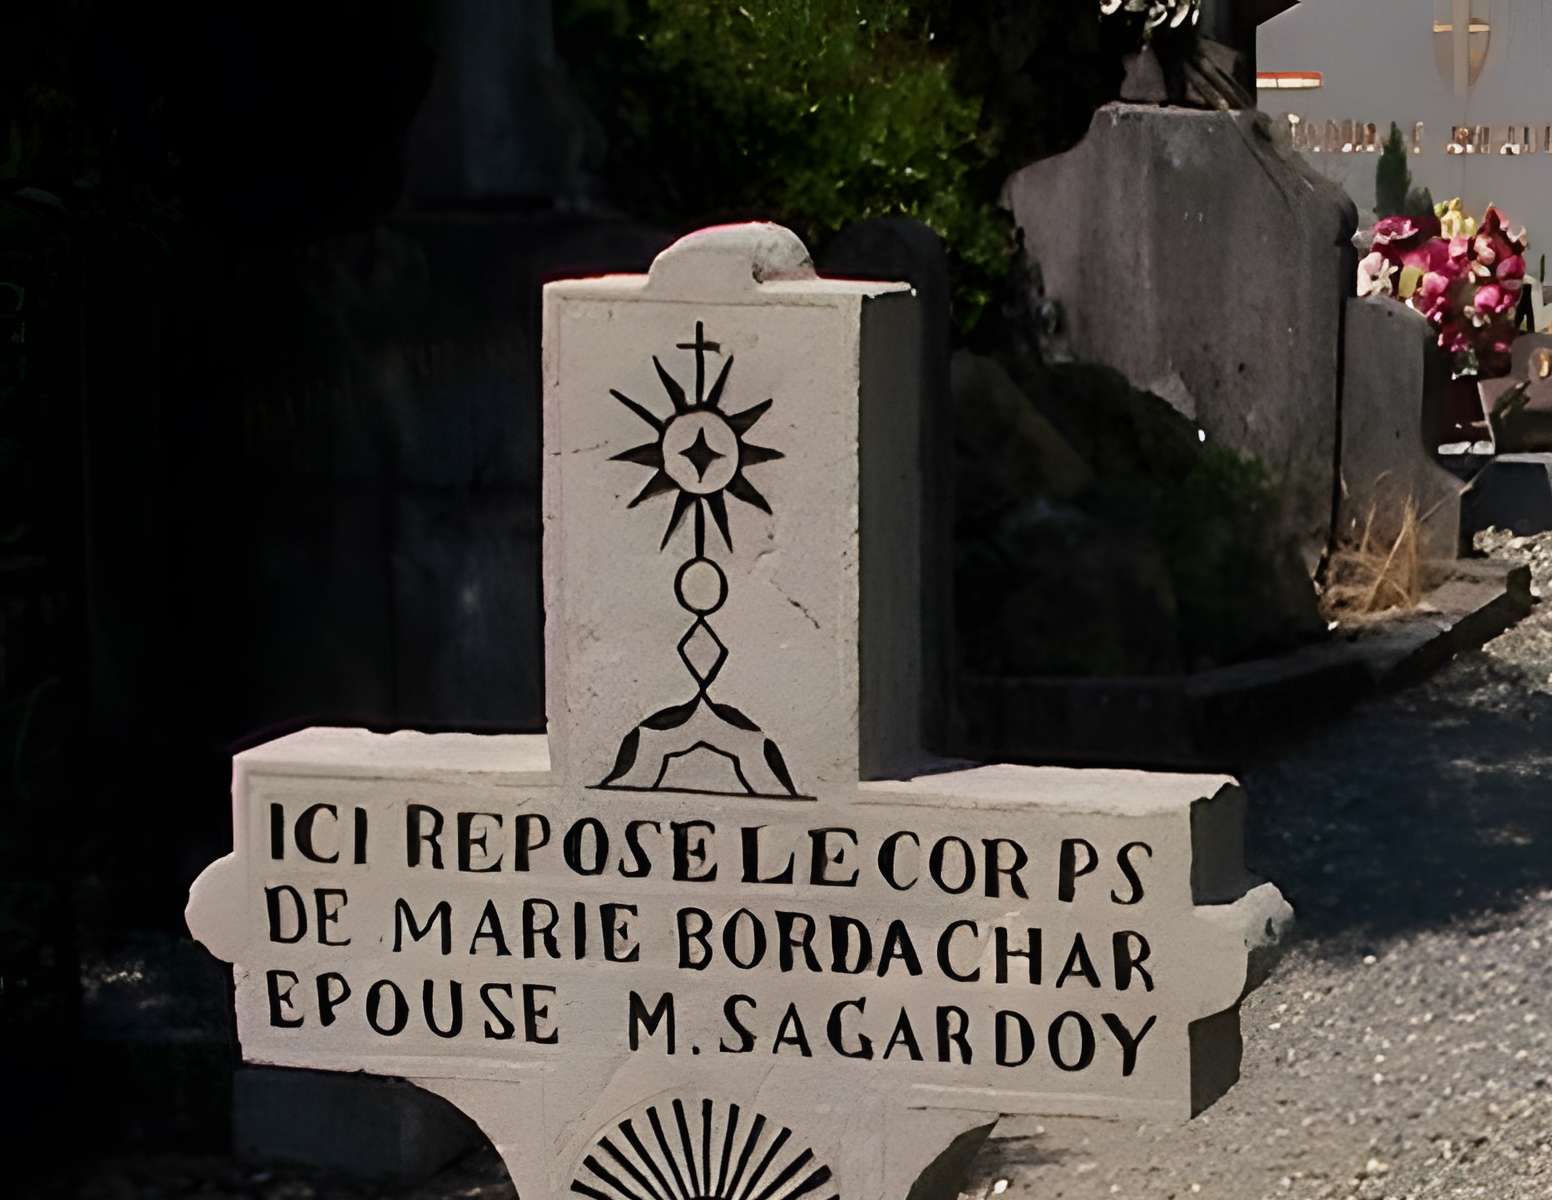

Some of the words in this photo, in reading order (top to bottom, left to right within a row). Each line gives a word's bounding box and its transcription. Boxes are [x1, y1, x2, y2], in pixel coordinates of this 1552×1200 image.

[271, 803, 367, 864] ICI
[407, 812, 719, 883] REPOSE
[741, 825, 859, 887] LE
[878, 831, 1152, 905] CORPS
[264, 885, 351, 946] DE
[393, 898, 640, 962] MARIE
[677, 907, 1154, 992] BORDACHAR
[266, 970, 558, 1044] EPOUSE
[627, 994, 701, 1056] M.
[720, 994, 1157, 1076] SAGARDOY
